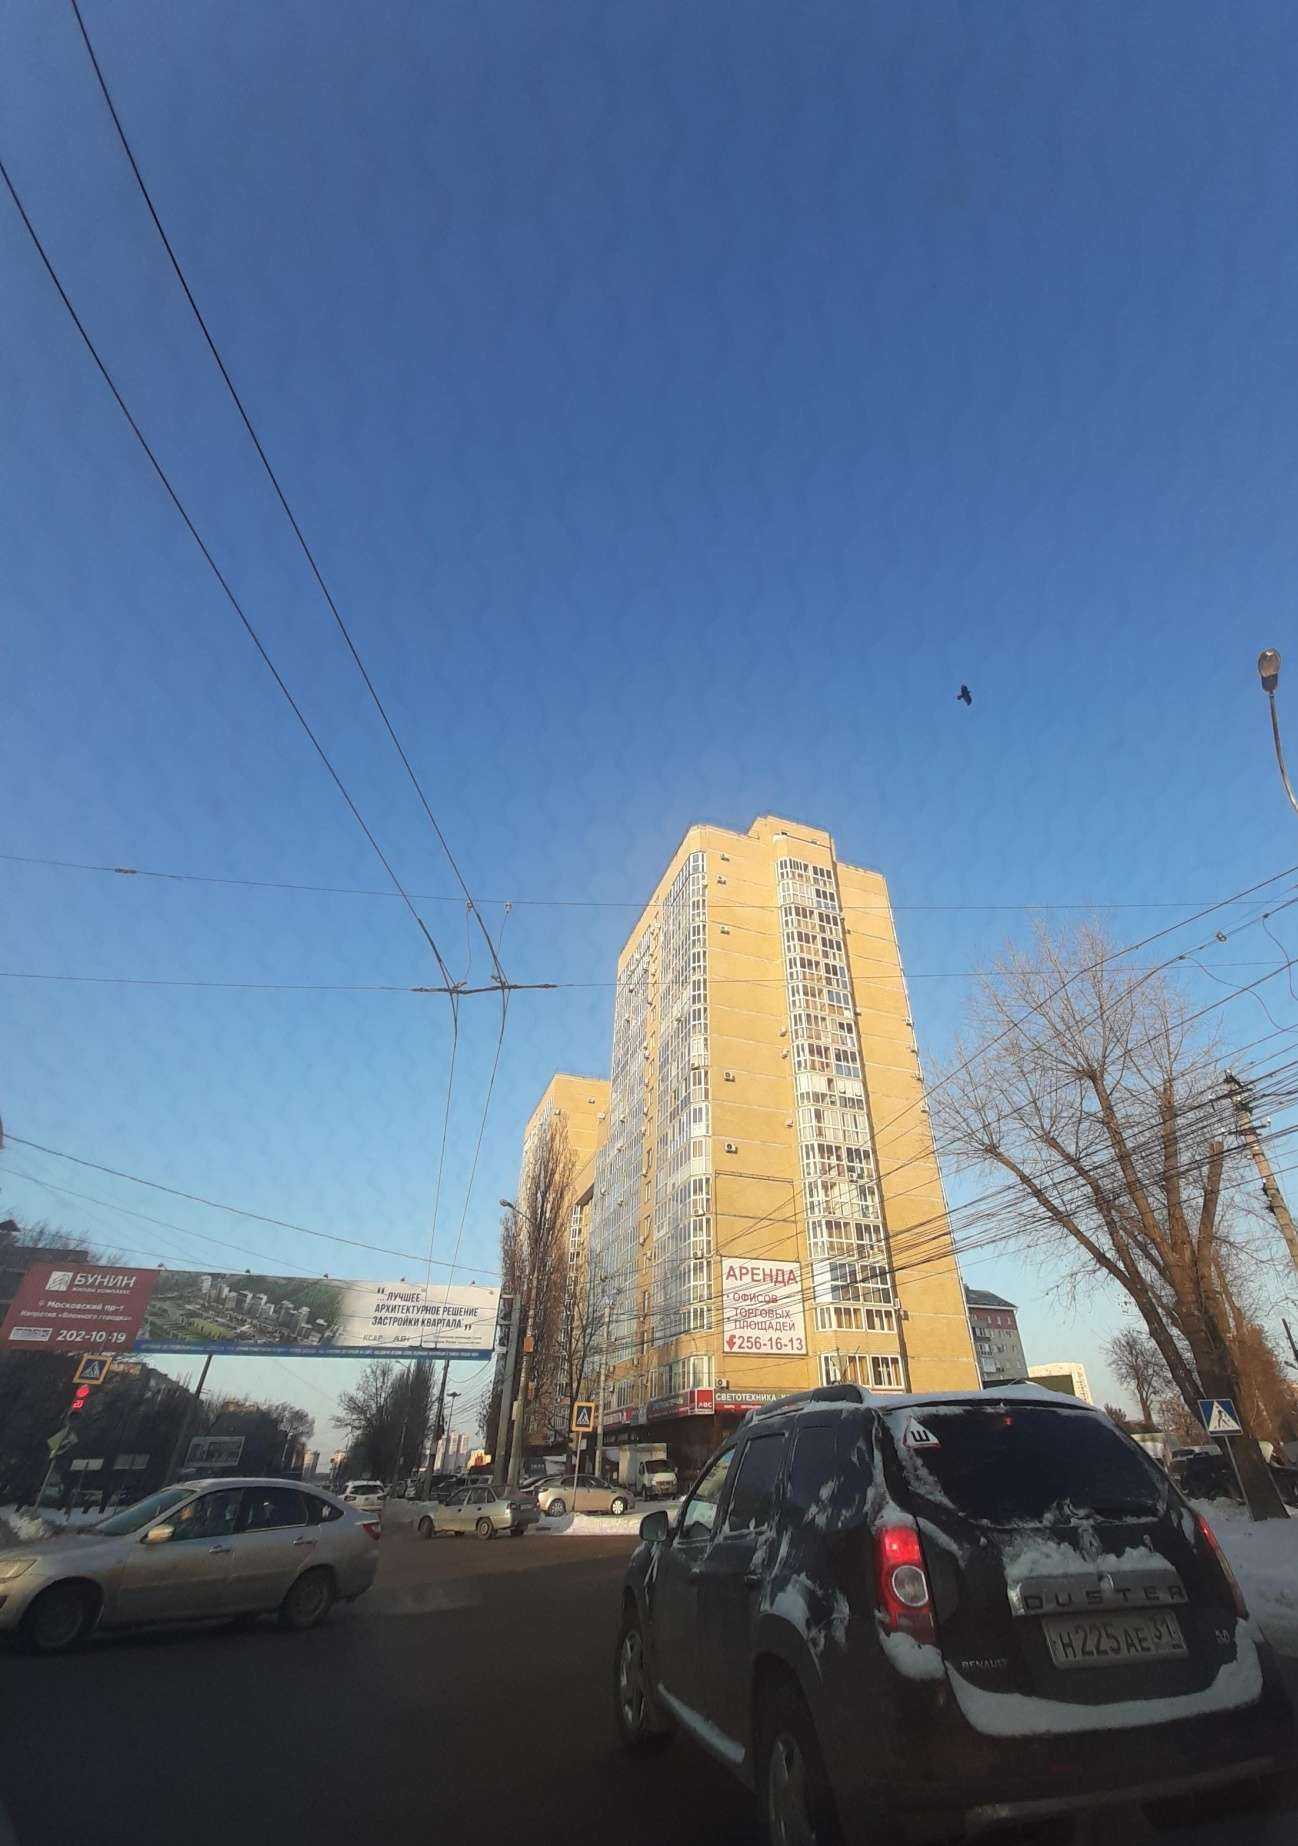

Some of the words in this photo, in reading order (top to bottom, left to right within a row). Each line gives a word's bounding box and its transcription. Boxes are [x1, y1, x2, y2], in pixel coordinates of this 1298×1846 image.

[73, 1273, 137, 1288] БУНИН
[725, 1264, 798, 1287] АРЕНДА
[732, 1292, 779, 1304] ОФИСОВ
[46, 1300, 103, 1311] Московский
[374, 1303, 442, 1317] АРХИТЕКТУРНОЕ
[442, 1306, 480, 1318] РЕШЕНИЕ
[734, 1307, 791, 1319] ТОРГОВЫХ
[371, 1315, 420, 1328] ЗАСТРОЙКИ
[734, 1319, 796, 1333] ПЛОЩАДЕЙ
[56, 1330, 127, 1343] 202-10-19
[737, 1335, 804, 1351] 256-16-13
[715, 1392, 777, 1402] СВЕТОТЕХНИКА
[1025, 1584, 1188, 1611] DUSTER
